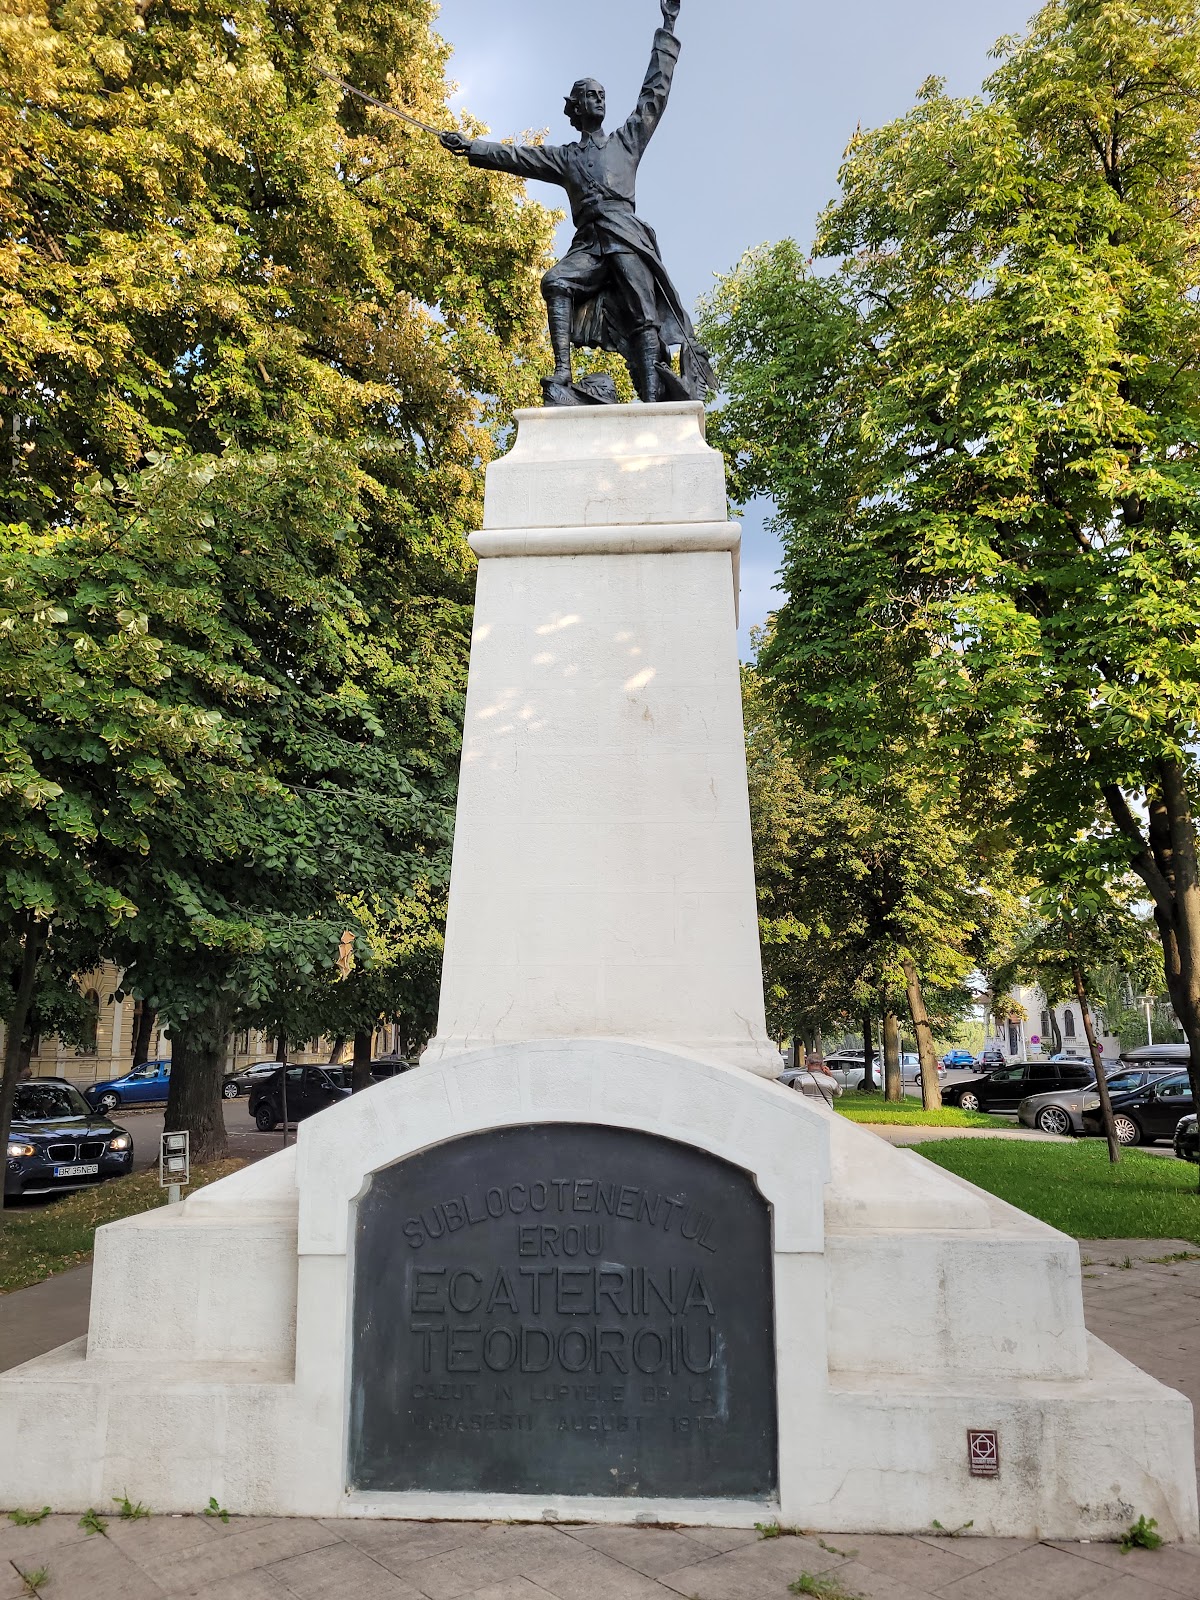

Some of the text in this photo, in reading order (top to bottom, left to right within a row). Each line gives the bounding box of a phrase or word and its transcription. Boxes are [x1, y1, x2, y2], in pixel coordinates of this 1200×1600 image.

[402, 1178, 717, 1253] SUBLOCOTENENTUL
[518, 1223, 603, 1257] EROU
[410, 1265, 716, 1316] ECATERINA
[410, 1323, 716, 1375] TEODOROIU
[689, 1384, 716, 1403] LA
[557, 1414, 644, 1432] AUGUST
[670, 1414, 716, 1432] 1917
